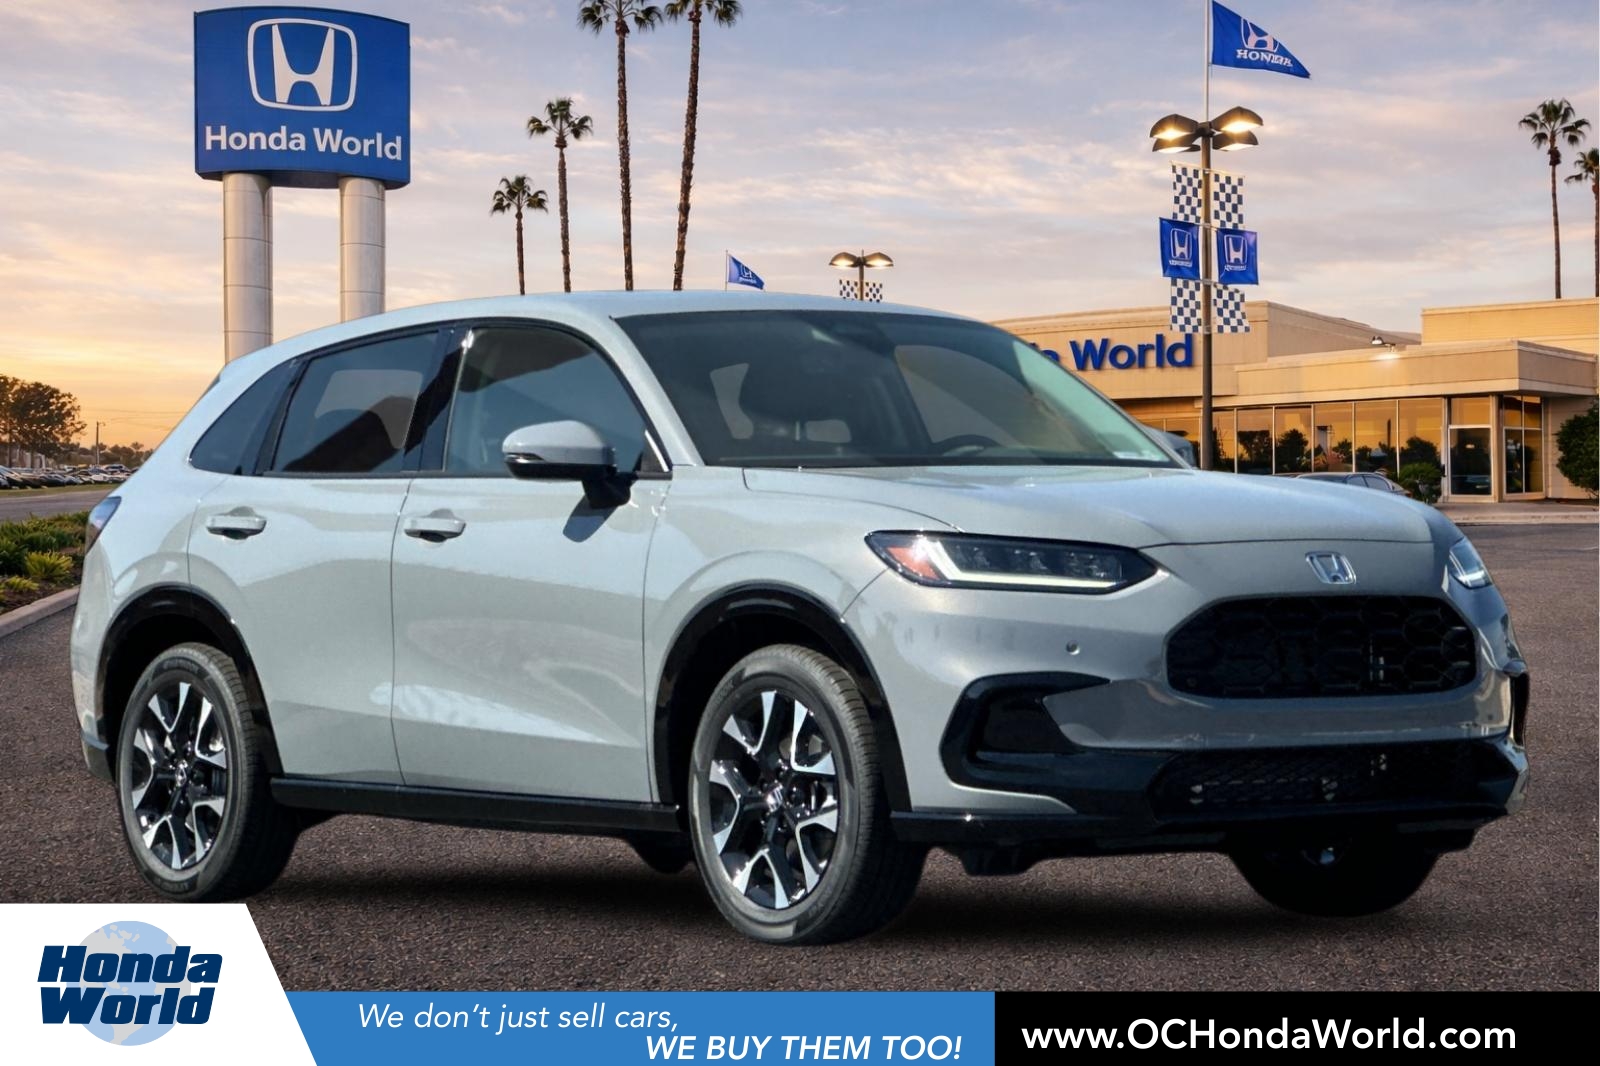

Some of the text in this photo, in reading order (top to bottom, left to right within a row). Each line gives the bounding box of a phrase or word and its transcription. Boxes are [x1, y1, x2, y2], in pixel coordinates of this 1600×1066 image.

[205, 125, 402, 161] Honda World
[1069, 333, 1194, 371] World
